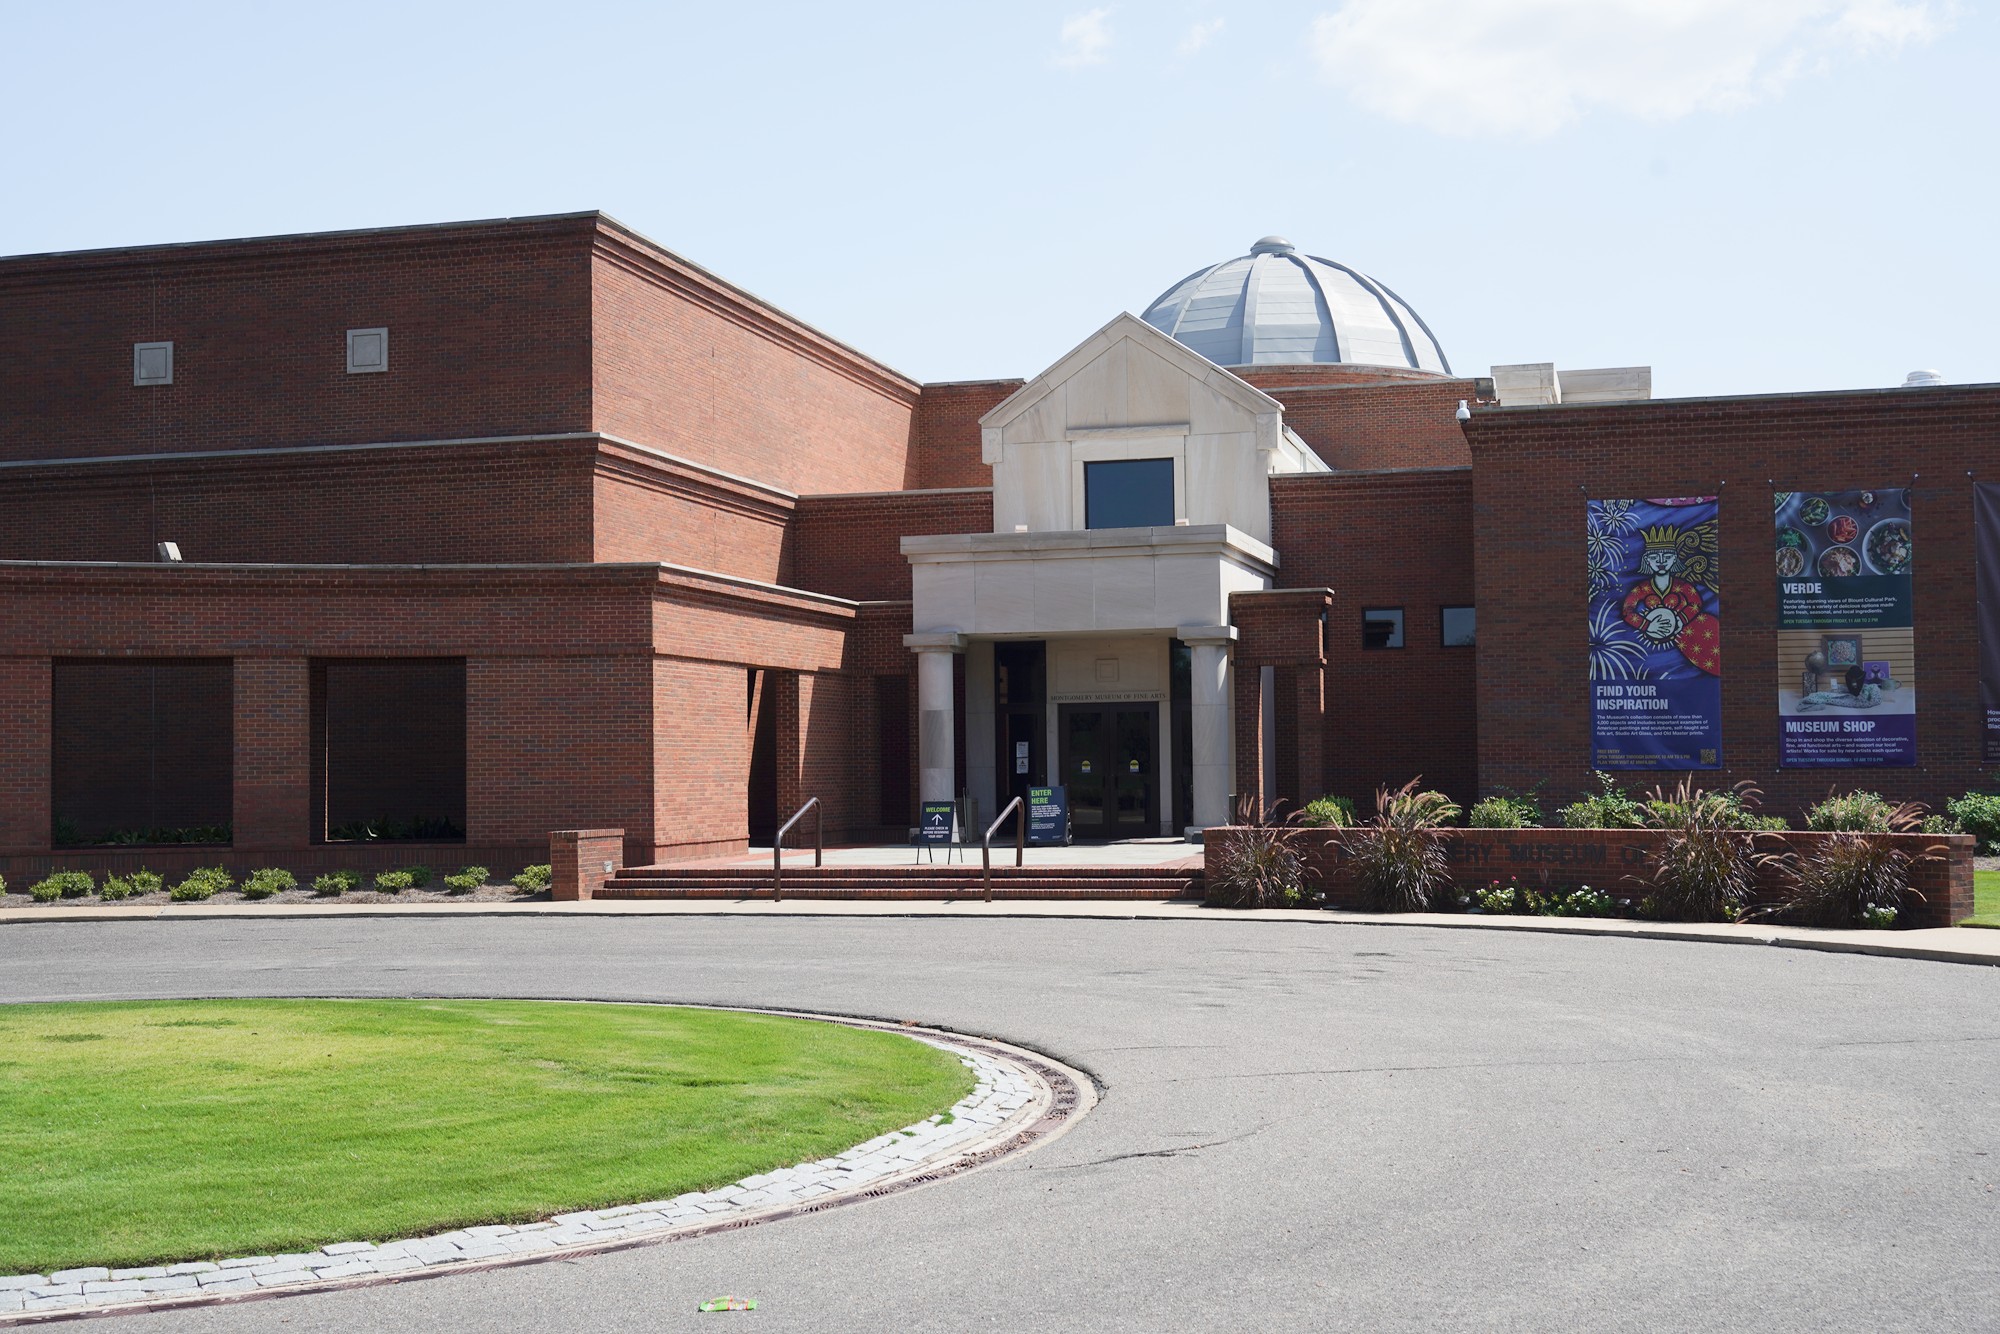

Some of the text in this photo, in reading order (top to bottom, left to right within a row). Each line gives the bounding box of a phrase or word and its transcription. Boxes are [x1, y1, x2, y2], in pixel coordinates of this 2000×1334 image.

[1783, 583, 1822, 594] VERDE
[1597, 686, 1657, 697] FIND YOUR
[1597, 699, 1669, 710] INSPIRATION
[1786, 721, 1875, 733] MUSEUM SHOP
[1509, 843, 1607, 865] MUSEUM
